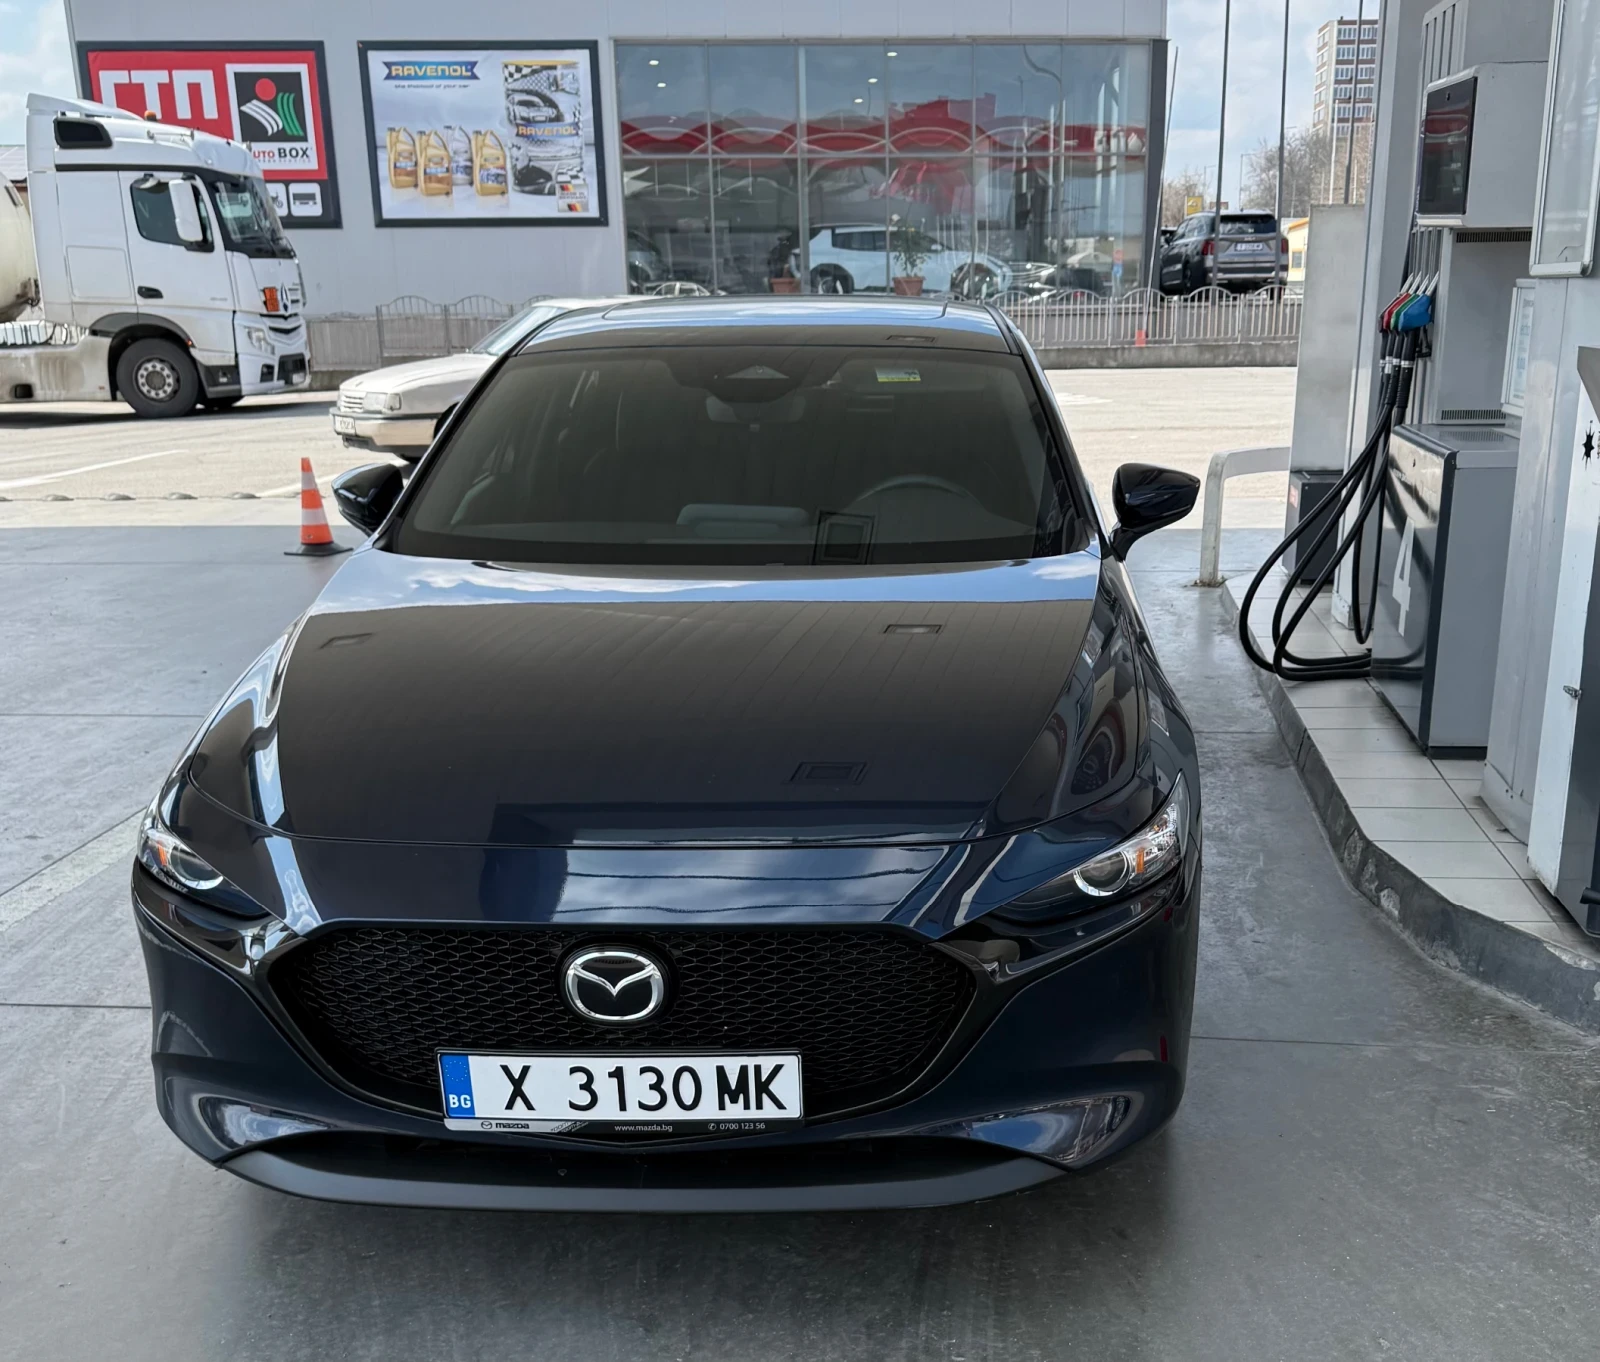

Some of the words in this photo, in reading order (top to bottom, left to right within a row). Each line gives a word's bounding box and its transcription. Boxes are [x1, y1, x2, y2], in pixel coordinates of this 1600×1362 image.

[391, 65, 472, 77] RAVENOL
[518, 125, 577, 137] RAVENOL
[253, 150, 275, 159] UTO
[277, 147, 309, 159] BOX
[1392, 515, 1415, 637] 4
[499, 1064, 536, 1111] X
[568, 1065, 703, 1111] 3130
[715, 1063, 788, 1111] MK
[449, 1094, 471, 1108] BG
[495, 1122, 530, 1130] mazda
[614, 1124, 673, 1132] www.mazda.bg
[741, 1122, 754, 1130] 123
[755, 1122, 766, 1130] 56
